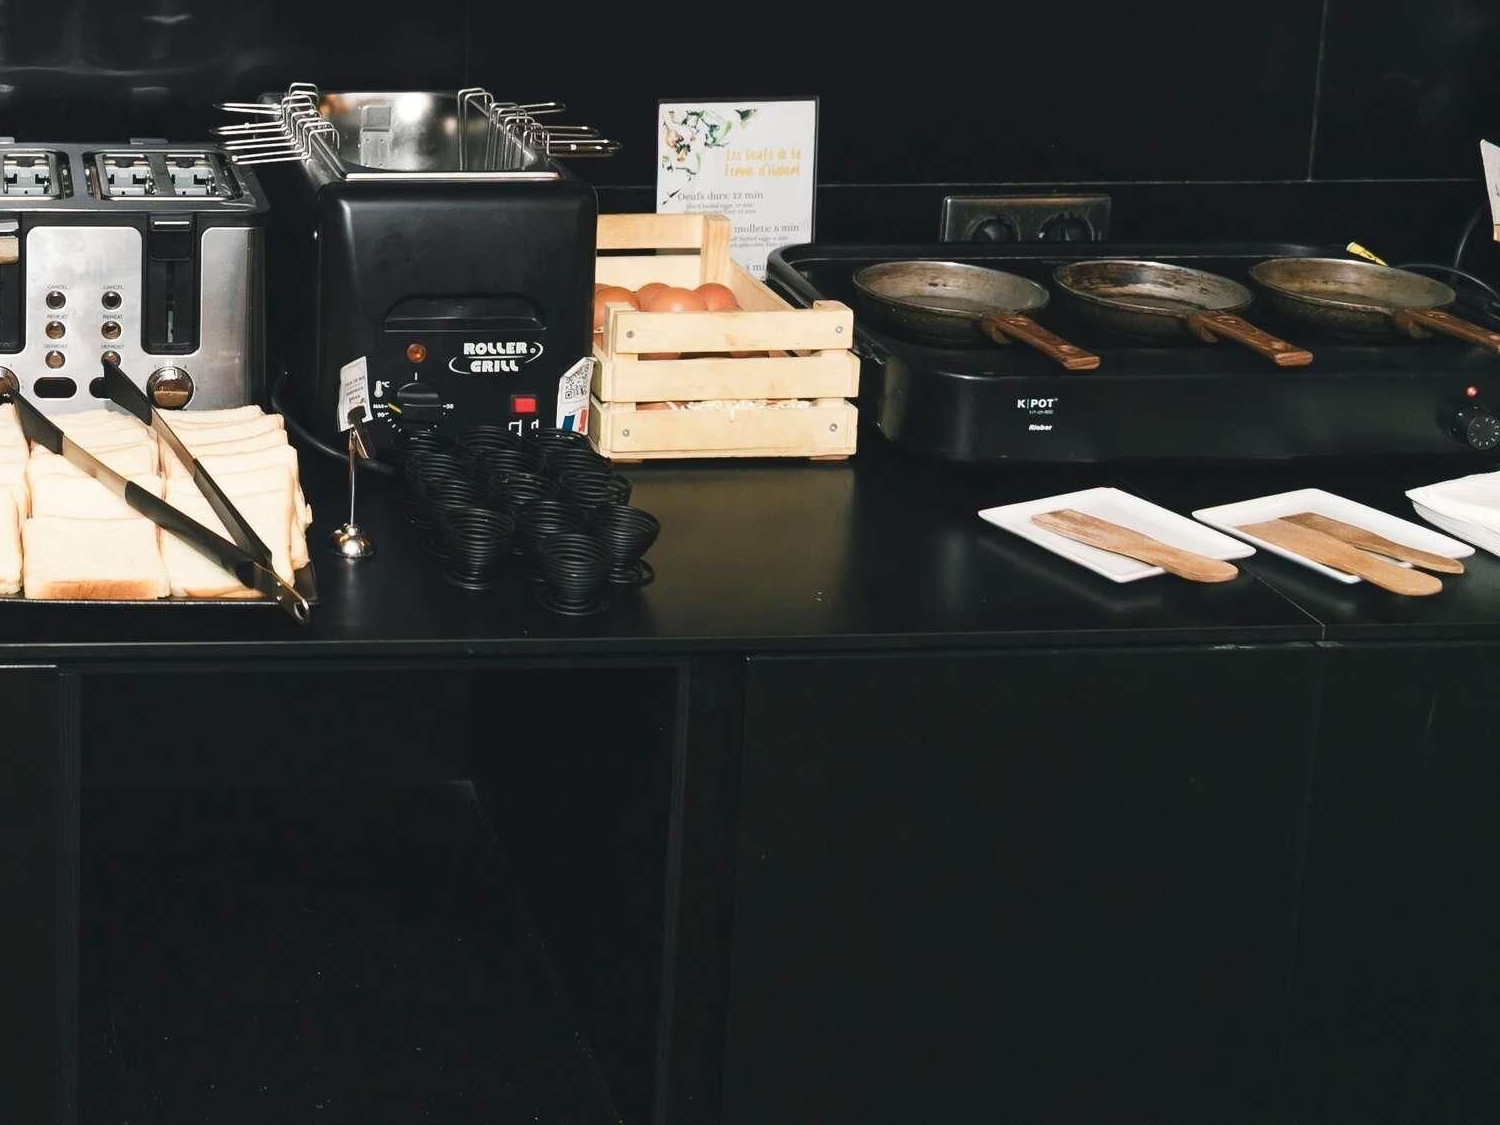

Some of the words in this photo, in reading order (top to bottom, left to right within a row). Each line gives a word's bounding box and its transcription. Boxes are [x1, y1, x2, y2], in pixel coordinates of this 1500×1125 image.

[745, 190, 763, 200] min
[463, 342, 528, 355] ROLLER
[470, 360, 519, 373] GRILL
